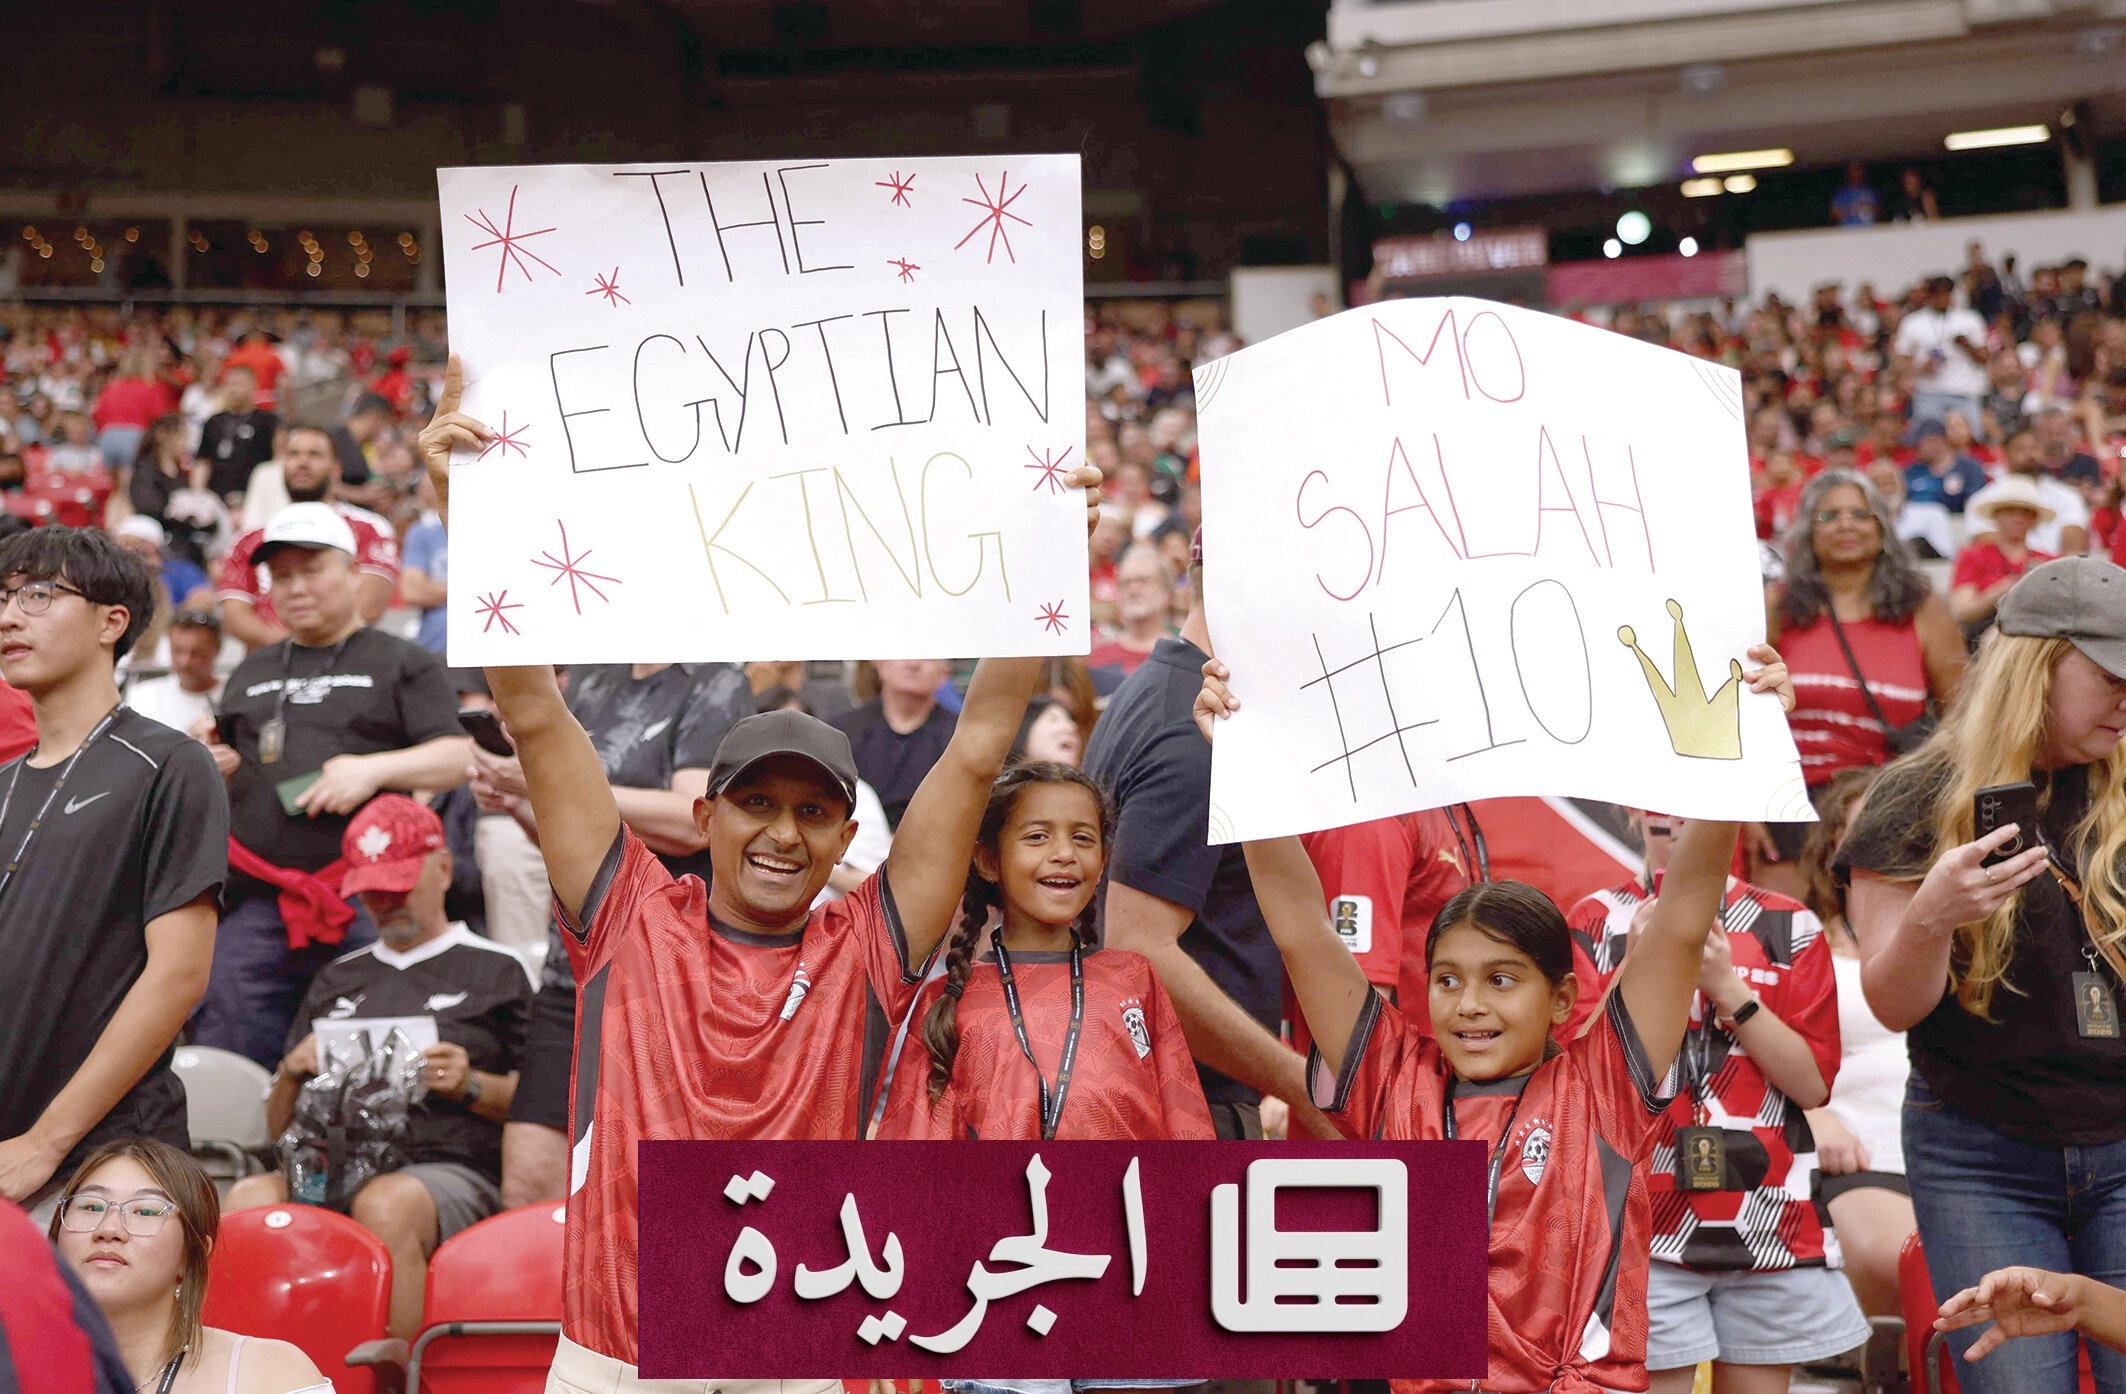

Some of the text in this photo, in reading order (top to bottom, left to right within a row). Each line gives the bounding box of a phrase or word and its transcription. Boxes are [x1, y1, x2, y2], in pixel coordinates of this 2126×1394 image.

[613, 164, 854, 287] THE
[551, 305, 1049, 473] EGYPTIAN
[1372, 309, 1526, 404] MO
[689, 452, 1011, 615] KING
[1298, 425, 1655, 602] SALAH
[1300, 579, 1593, 803] #10
